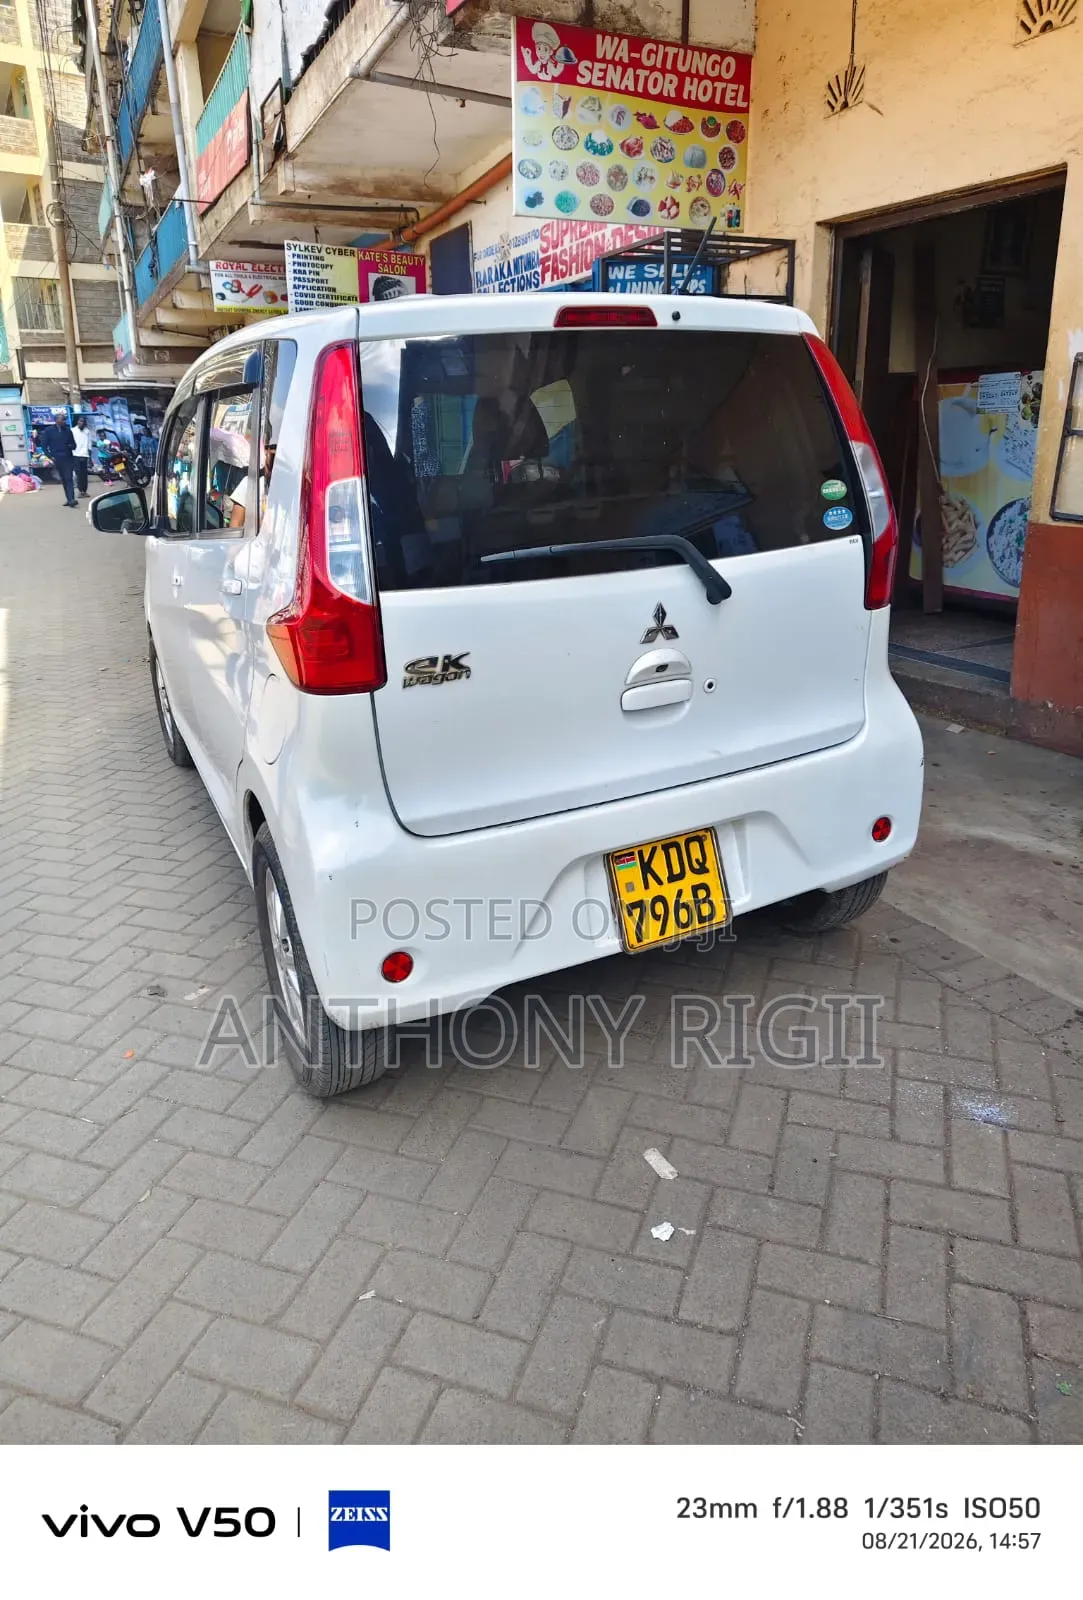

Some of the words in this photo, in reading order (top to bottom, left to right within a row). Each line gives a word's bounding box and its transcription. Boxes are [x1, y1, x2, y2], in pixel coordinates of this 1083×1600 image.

[596, 34, 736, 80] WA-GITUNGO
[576, 60, 678, 97] SENATOR
[683, 76, 748, 108] HOTEL
[286, 243, 322, 254] SYLKEV
[325, 247, 356, 257] CYBER
[292, 253, 325, 262] PRINTING
[215, 261, 248, 271] ROYAL
[292, 261, 334, 270] PHOTOCOPY
[358, 252, 388, 263] KATE'S
[391, 254, 425, 266] BEAUTY
[540, 232, 607, 285] FASHION
[377, 264, 407, 275] SALON
[608, 264, 636, 280] WE
[293, 276, 329, 285] PASSPORT
[476, 270, 540, 293] ECTIONS
[292, 284, 337, 293] APPLICATION
[402, 670, 471, 689] wagon
[637, 835, 710, 890] KDQ
[625, 882, 716, 943] 796B
